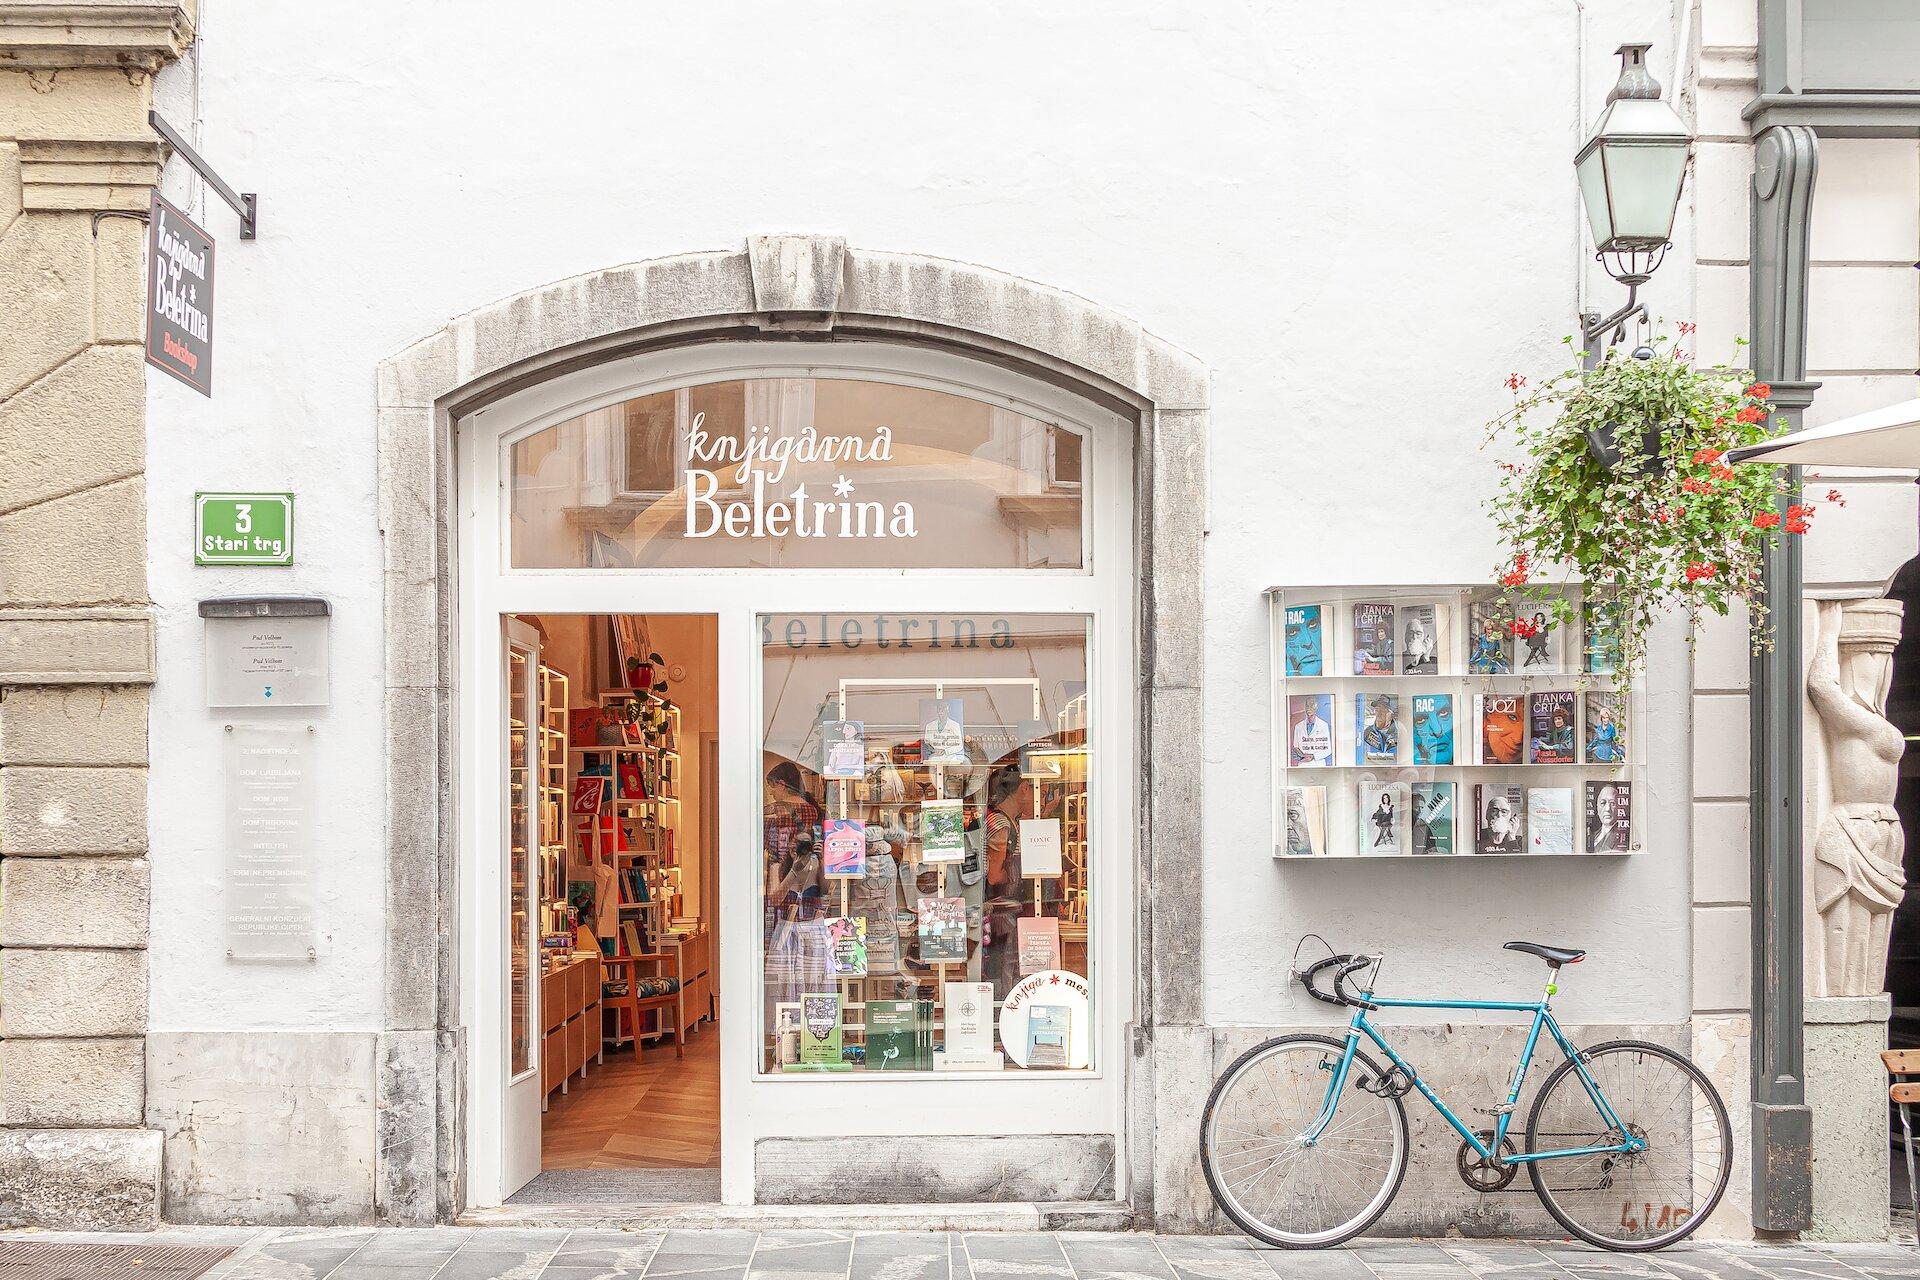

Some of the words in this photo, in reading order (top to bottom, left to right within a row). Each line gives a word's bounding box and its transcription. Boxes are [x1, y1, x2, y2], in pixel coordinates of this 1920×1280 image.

[157, 209, 206, 281] knjigarna
[154, 254, 208, 343] Beletrina
[162, 331, 199, 376] Bookshop
[683, 411, 894, 484] knjigarna
[683, 469, 919, 538] Beletrina
[235, 503, 252, 534] 3
[204, 535, 248, 551] Stari
[253, 536, 282, 555] trg
[1287, 610, 1305, 625] RAC
[1361, 613, 1384, 624] ČRTA
[1364, 605, 1394, 616] TANKA
[1416, 699, 1435, 712] RAC
[1487, 696, 1517, 713] JOŽI
[1537, 693, 1573, 703] TANKA
[1533, 700, 1561, 713] ČRTA
[1617, 786, 1630, 794] TRI
[1427, 792, 1444, 811] NIKO
[1617, 797, 1629, 805] UM
[1617, 808, 1626, 817] FA
[1617, 820, 1630, 828] TOR
[1005, 977, 1045, 1012] knjiga
